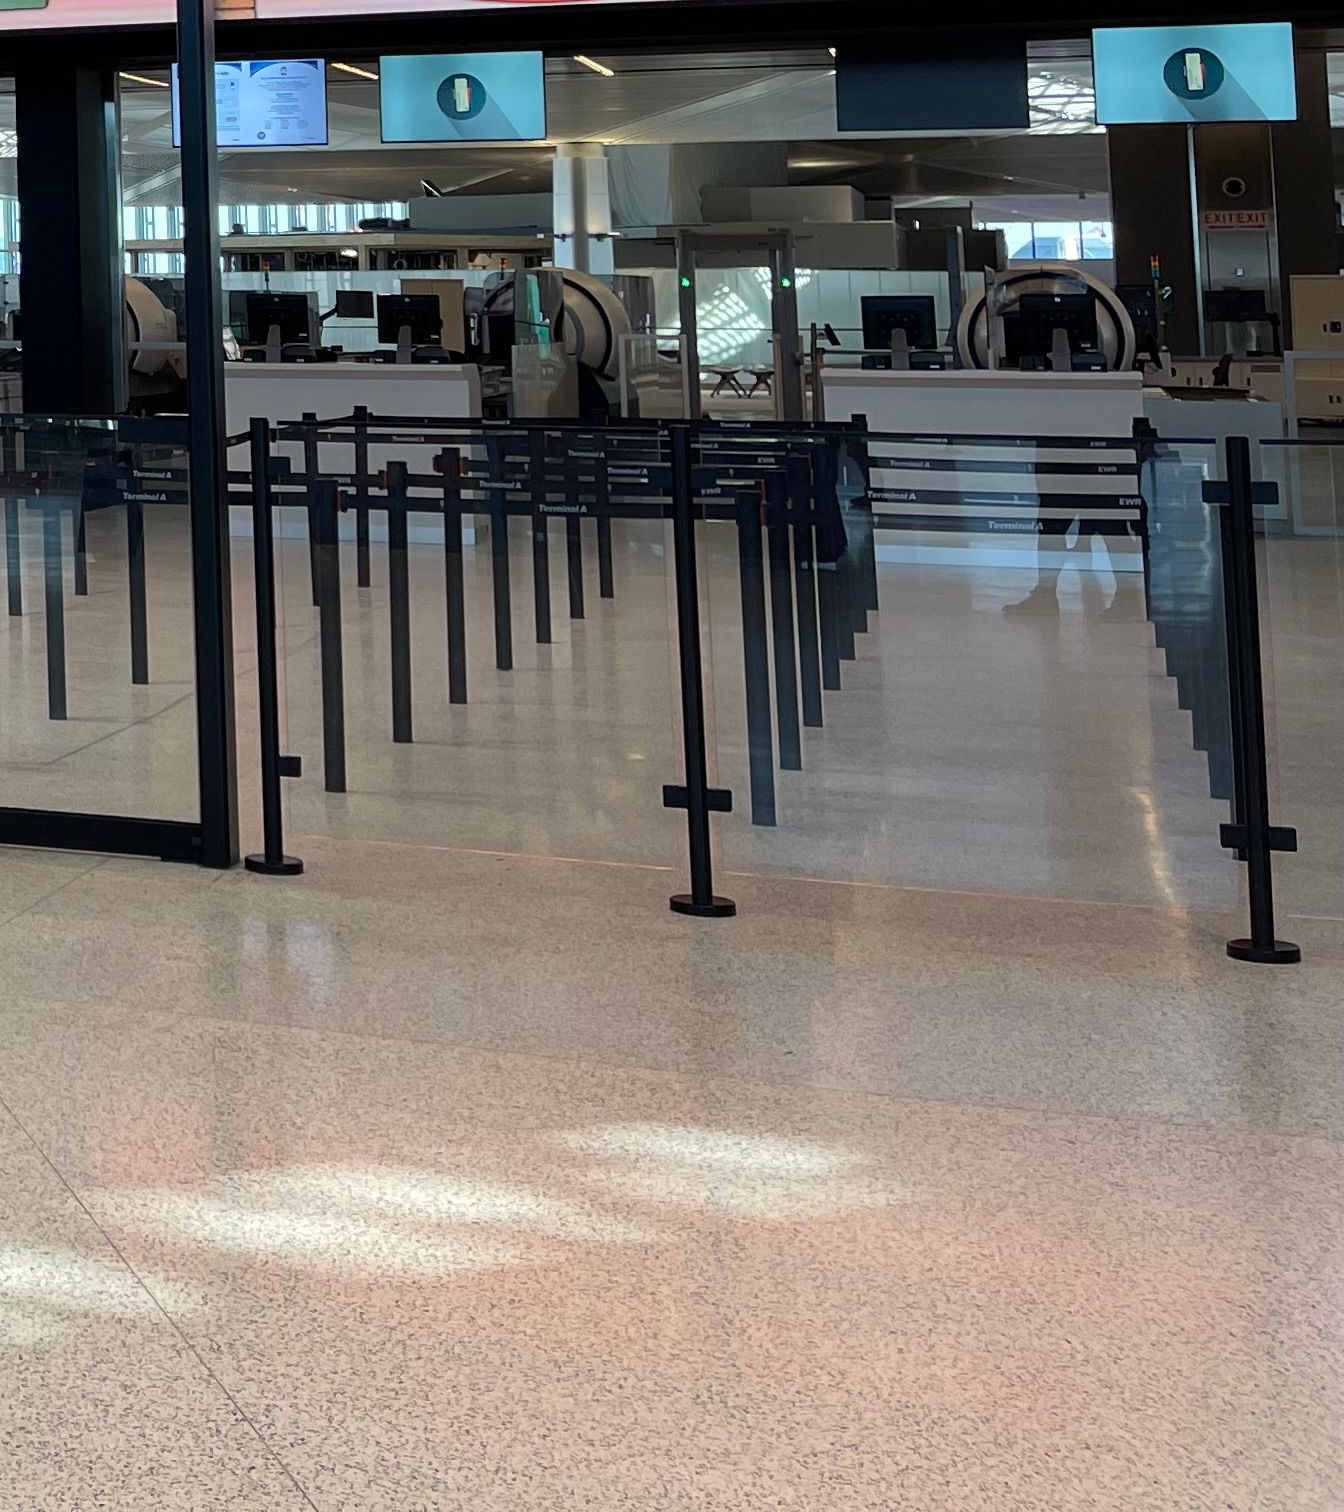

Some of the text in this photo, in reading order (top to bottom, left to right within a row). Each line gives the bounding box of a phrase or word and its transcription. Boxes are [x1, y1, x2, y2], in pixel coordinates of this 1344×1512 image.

[1205, 212, 1235, 224] EXIT
[1237, 212, 1267, 224] EXIT
[123, 492, 159, 500] Terminal
[867, 490, 908, 500] Terminal
[1119, 497, 1141, 506] EWR
[987, 520, 1035, 530] Terminal
